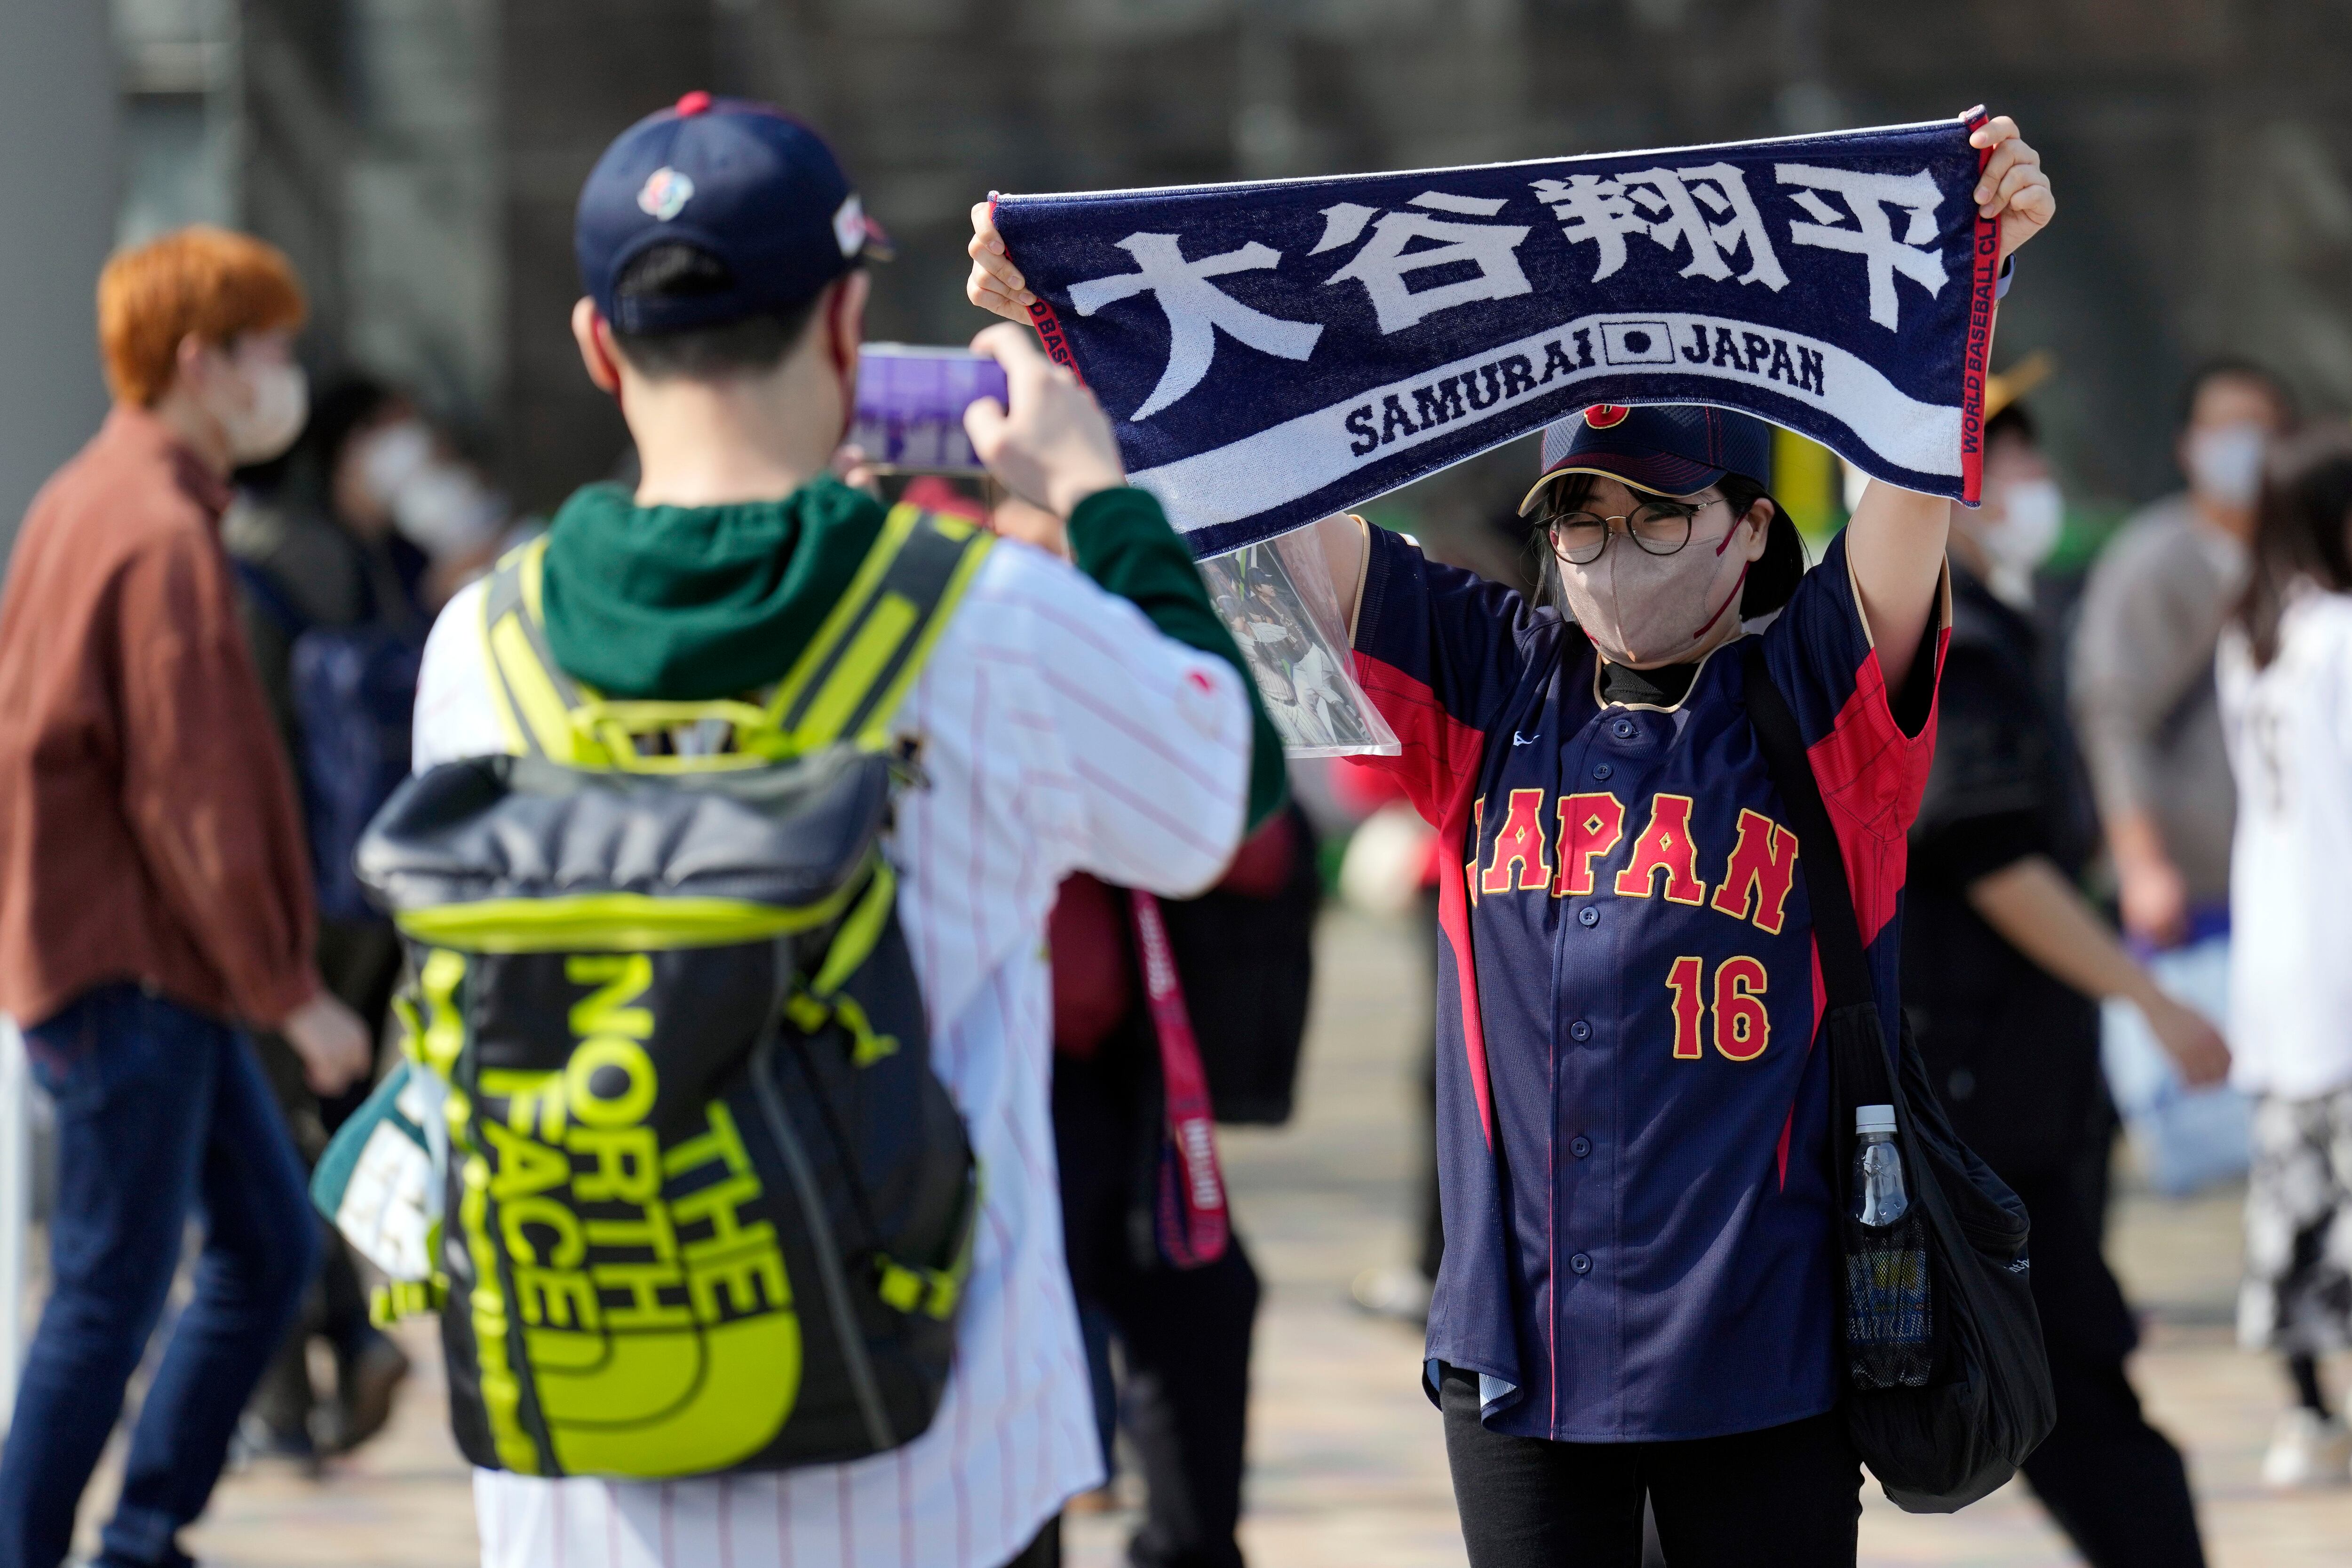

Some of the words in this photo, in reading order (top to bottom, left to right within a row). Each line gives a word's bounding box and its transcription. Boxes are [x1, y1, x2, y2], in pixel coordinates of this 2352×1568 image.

[1067, 162, 1949, 422] 大谷翔平
[1978, 217, 1997, 254] CL
[1970, 261, 1993, 370] BASEBALL
[1344, 327, 1596, 457] SAMURAI
[1681, 324, 1825, 397] JAPAN
[1963, 377, 1980, 455] WORLD
[1665, 955, 1772, 1061] 16
[481, 1069, 601, 1330] FACE
[564, 953, 694, 1329] NORTH
[664, 1099, 794, 1323] THE
